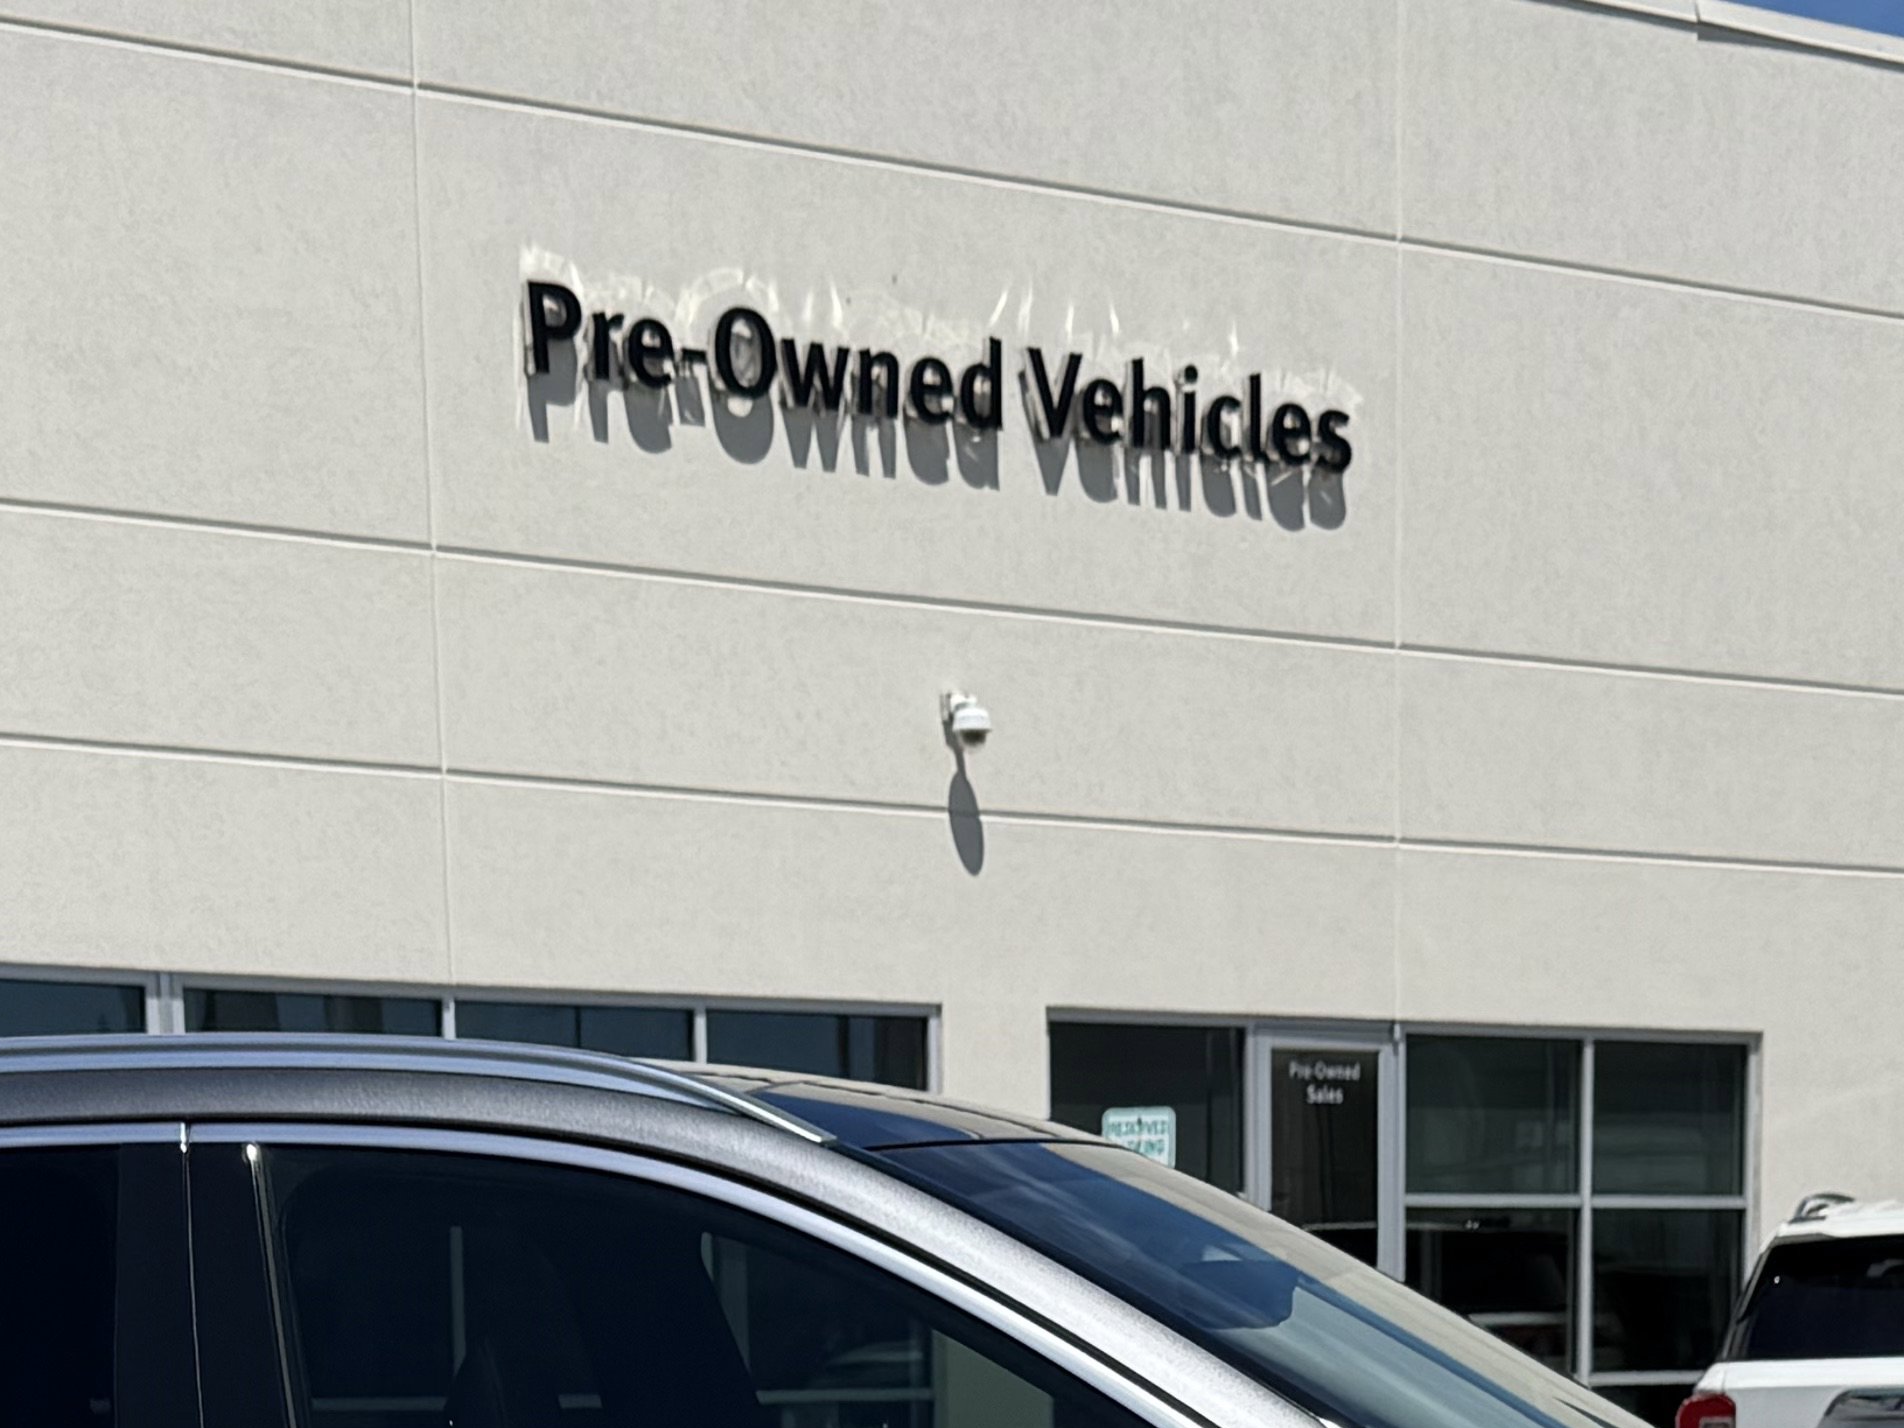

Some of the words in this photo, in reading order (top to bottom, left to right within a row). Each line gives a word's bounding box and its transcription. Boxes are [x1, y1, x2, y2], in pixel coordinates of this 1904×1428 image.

[524, 280, 1004, 432] Pre-Owned
[1022, 346, 1354, 476] Vehicles
[1288, 1059, 1362, 1083] Pre-Owned
[1306, 1083, 1345, 1105] Sales
